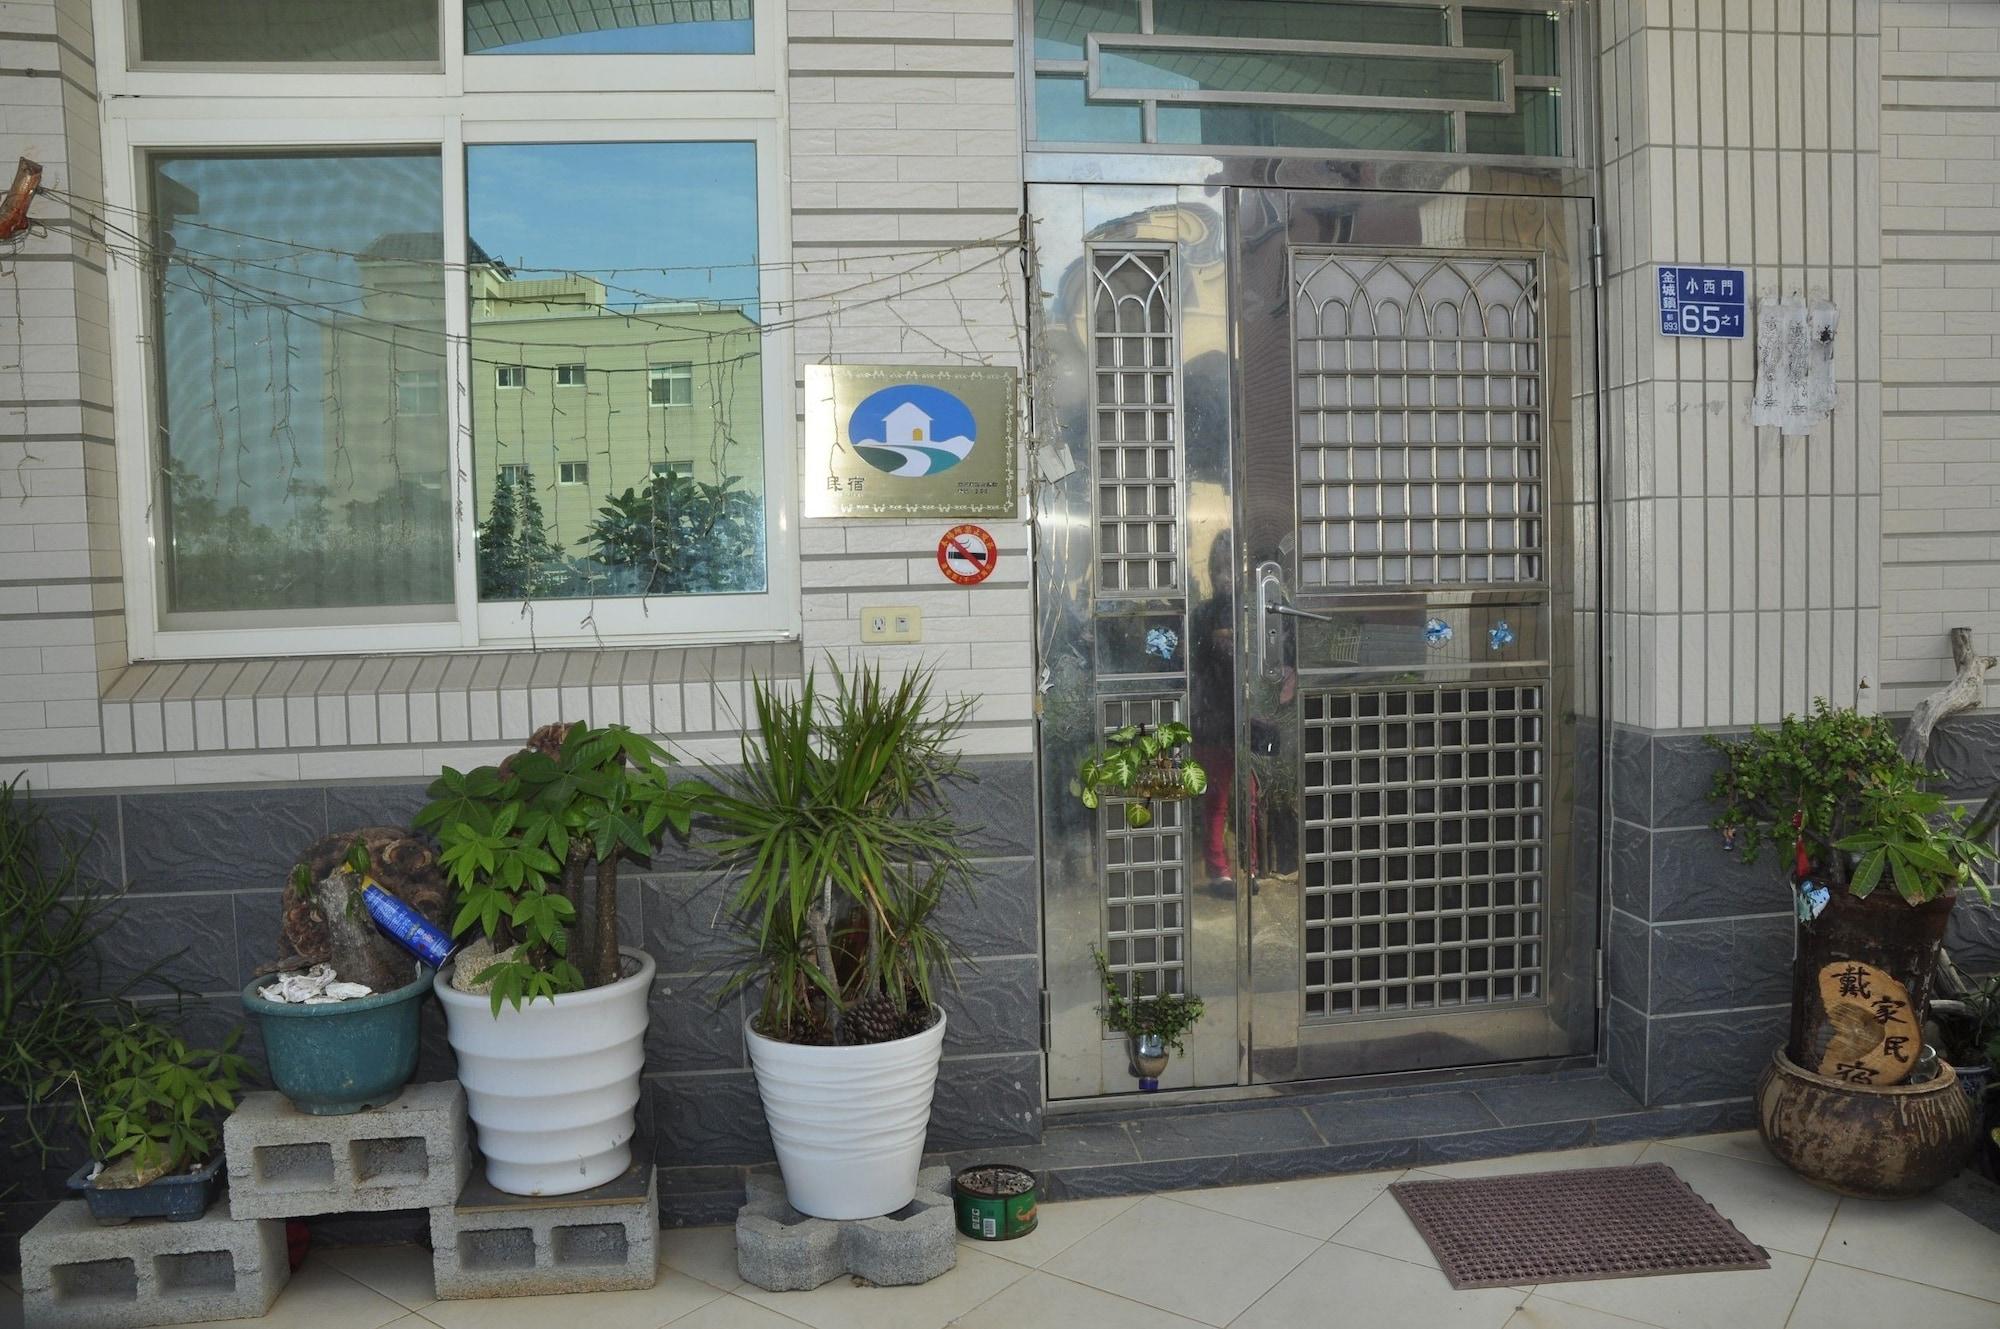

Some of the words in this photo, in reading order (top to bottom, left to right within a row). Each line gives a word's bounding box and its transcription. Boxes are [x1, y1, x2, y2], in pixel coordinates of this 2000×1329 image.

[1661, 271, 1676, 308] 金城鎮
[1686, 278, 1733, 296] 小西門
[1663, 322, 1678, 331] 893
[827, 477, 865, 491] 民宿
